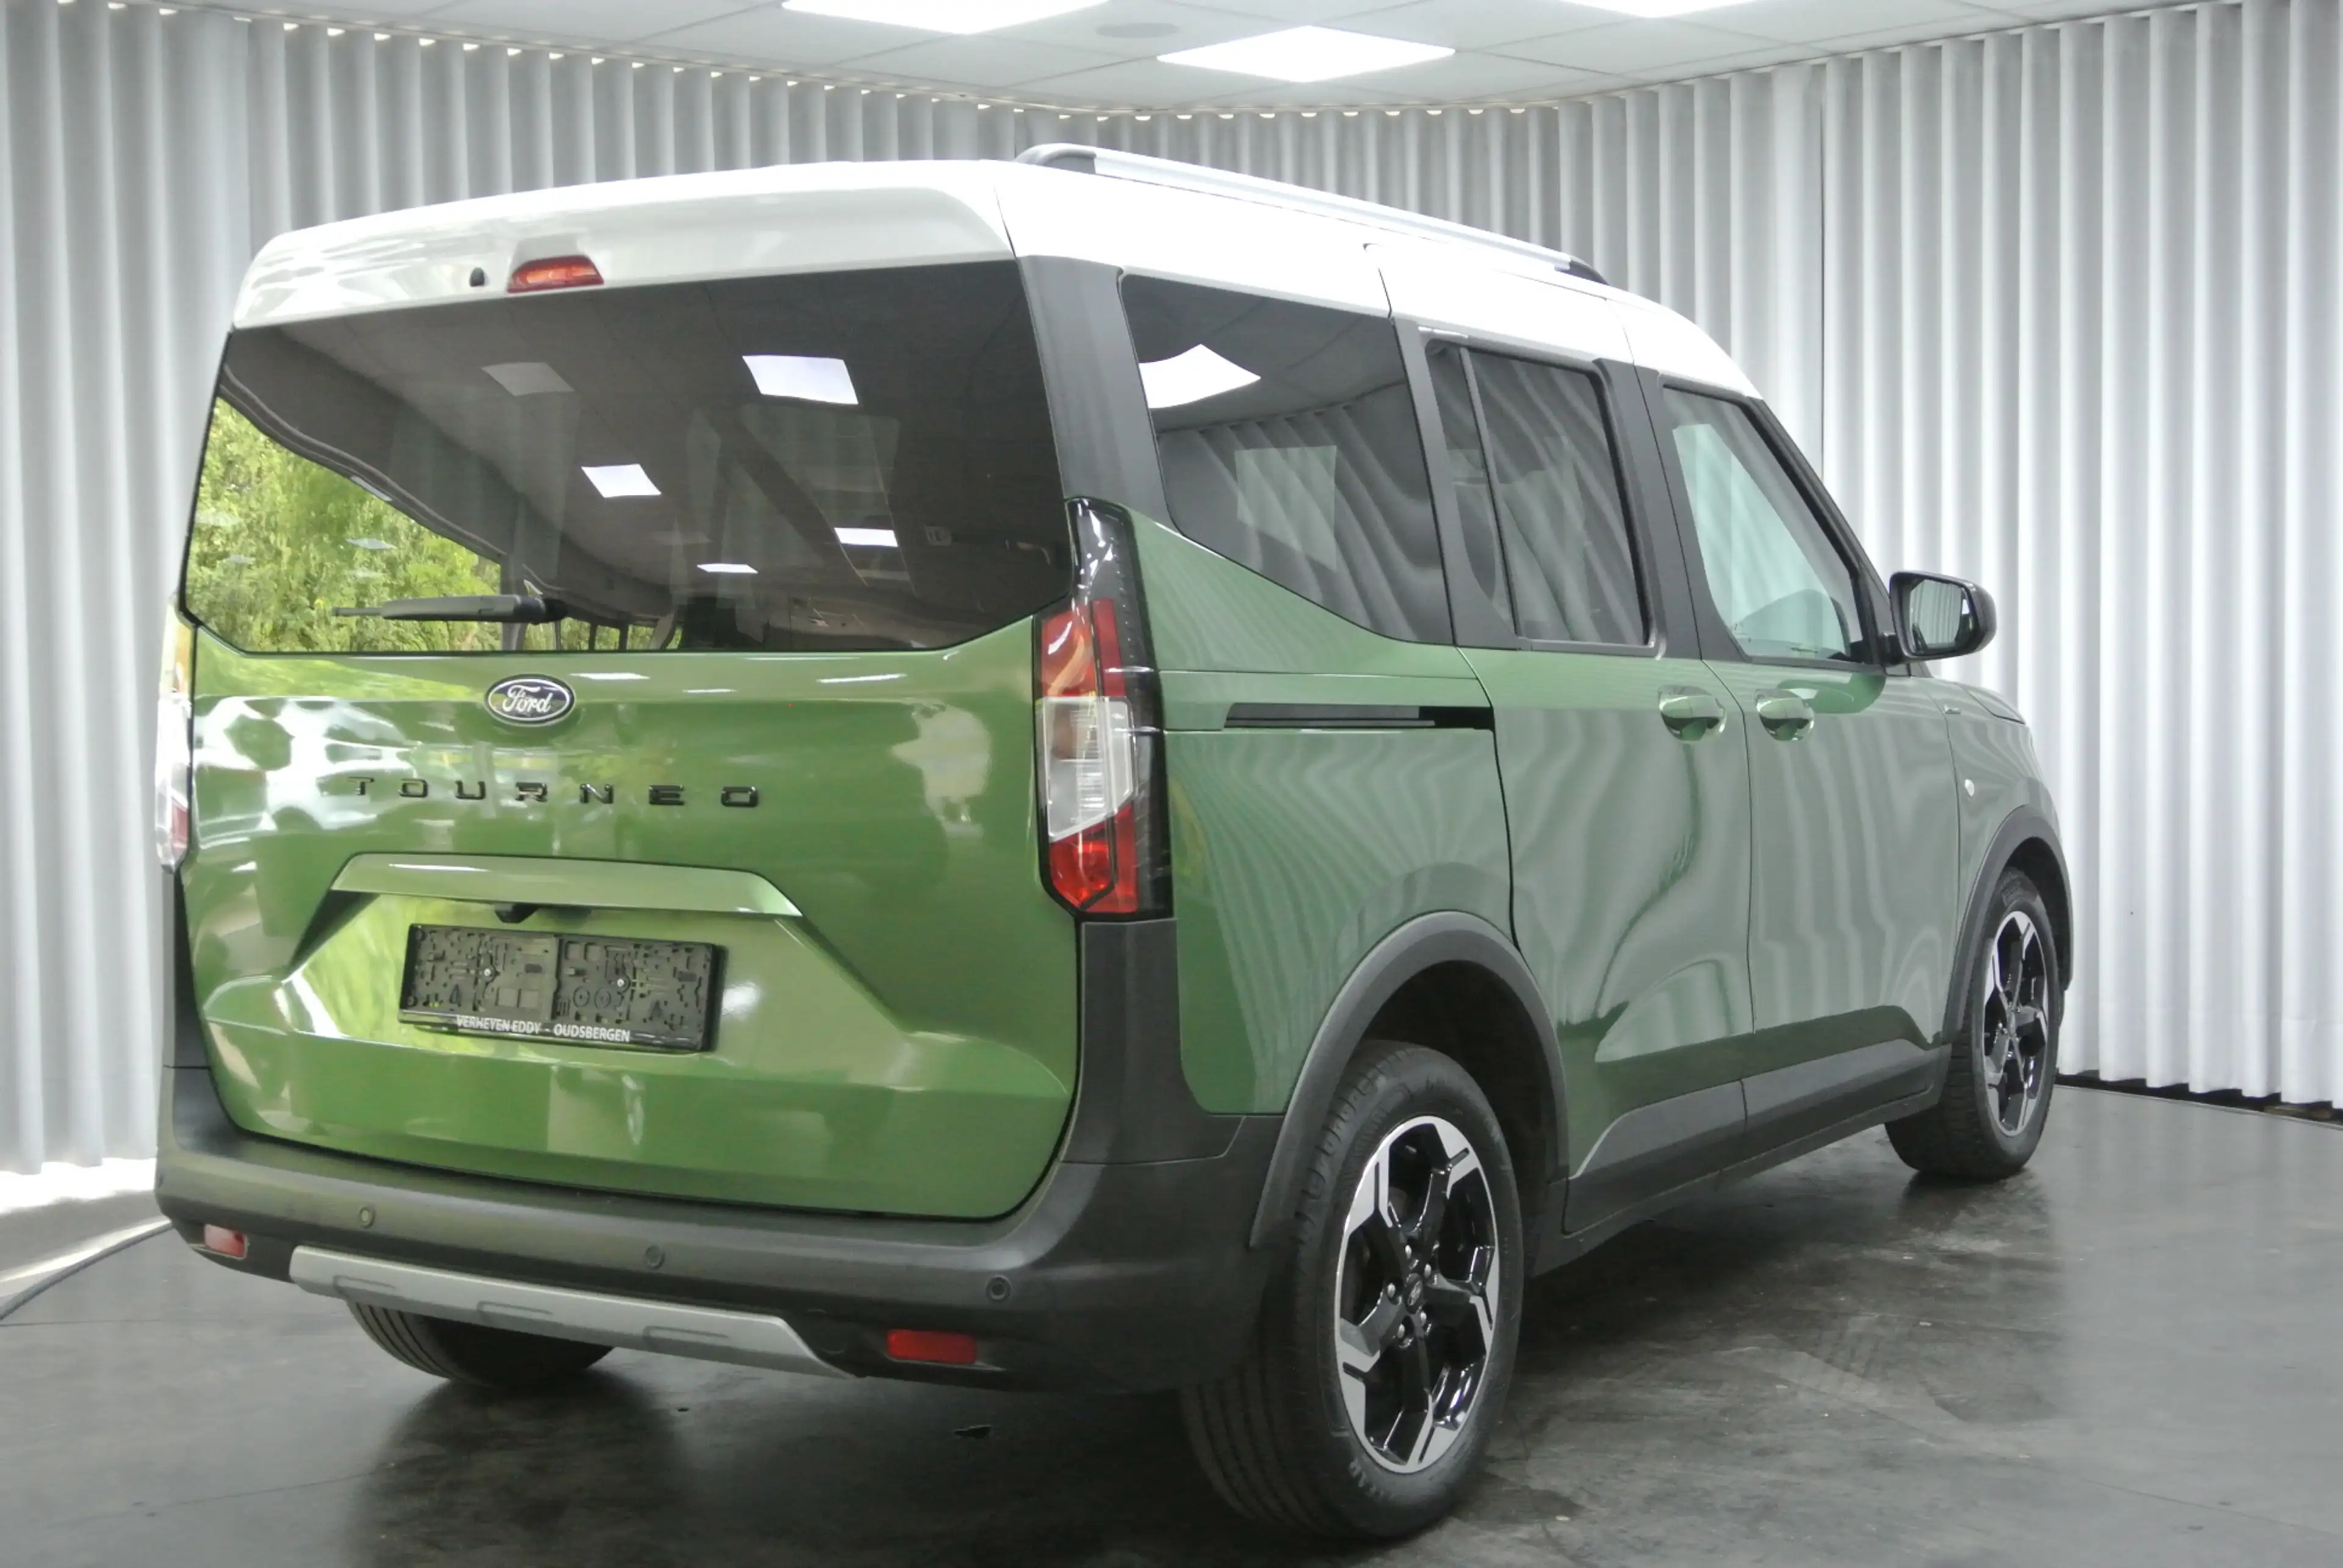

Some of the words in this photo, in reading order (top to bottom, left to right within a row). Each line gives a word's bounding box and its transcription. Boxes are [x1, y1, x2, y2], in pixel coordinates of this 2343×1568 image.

[502, 685, 553, 713] Ford
[348, 777, 759, 808] TOURNEO
[456, 1015, 510, 1032] VERHEYEN
[511, 1020, 542, 1035] EDDY
[553, 1023, 631, 1043] OUDSBERGEN
